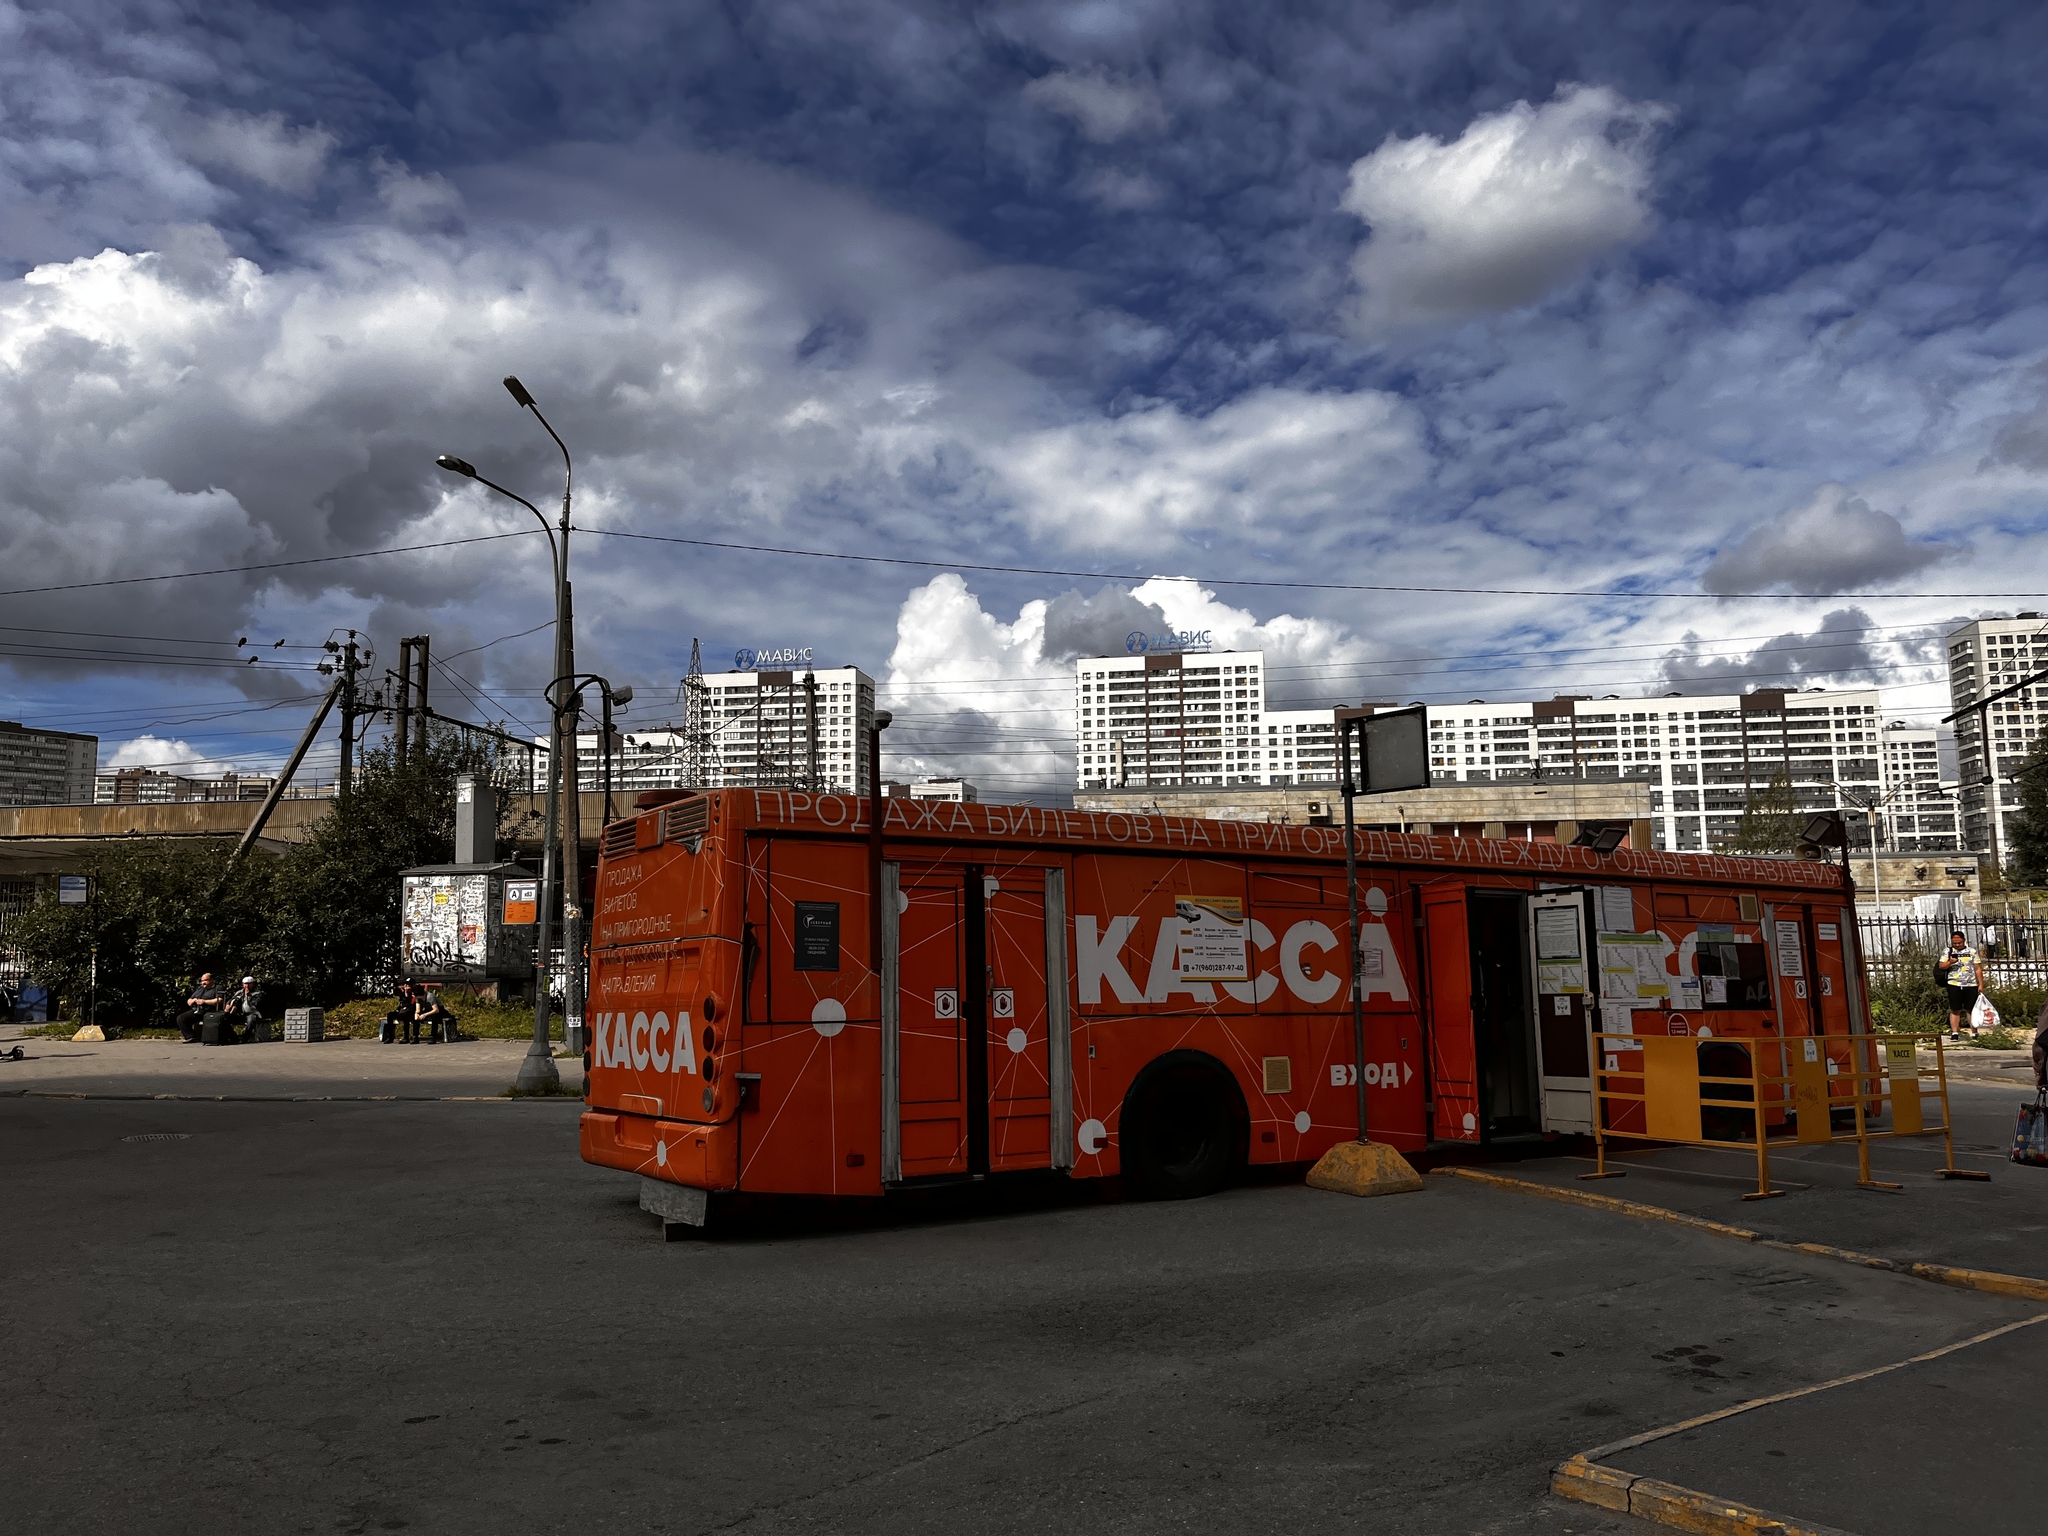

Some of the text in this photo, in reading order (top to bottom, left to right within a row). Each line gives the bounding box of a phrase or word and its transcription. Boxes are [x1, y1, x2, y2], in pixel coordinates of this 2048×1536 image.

[1150, 630, 1212, 646] МАВИС
[756, 647, 813, 662] МАВИС
[753, 789, 1842, 886] ПРОДАЖА БИЛЕТОВ НА ПРИГОРОДНЫЕ И МЕЖДУГОРОДНЫЕ НАПРАВЛЕНИЯ
[605, 864, 643, 888] ПРОДАЖА
[603, 892, 638, 915] БИЛЕТОВ
[601, 913, 672, 940] НА ПРИГОРОДНЫЕ
[1076, 914, 1409, 1005] КАССА
[1191, 964, 1244, 972] +7(960)287-97-40
[600, 974, 657, 994] НАПРАВЛЕНИЯ
[594, 1010, 698, 1075] КАССА
[1893, 1049, 1910, 1058] КАССЕ
